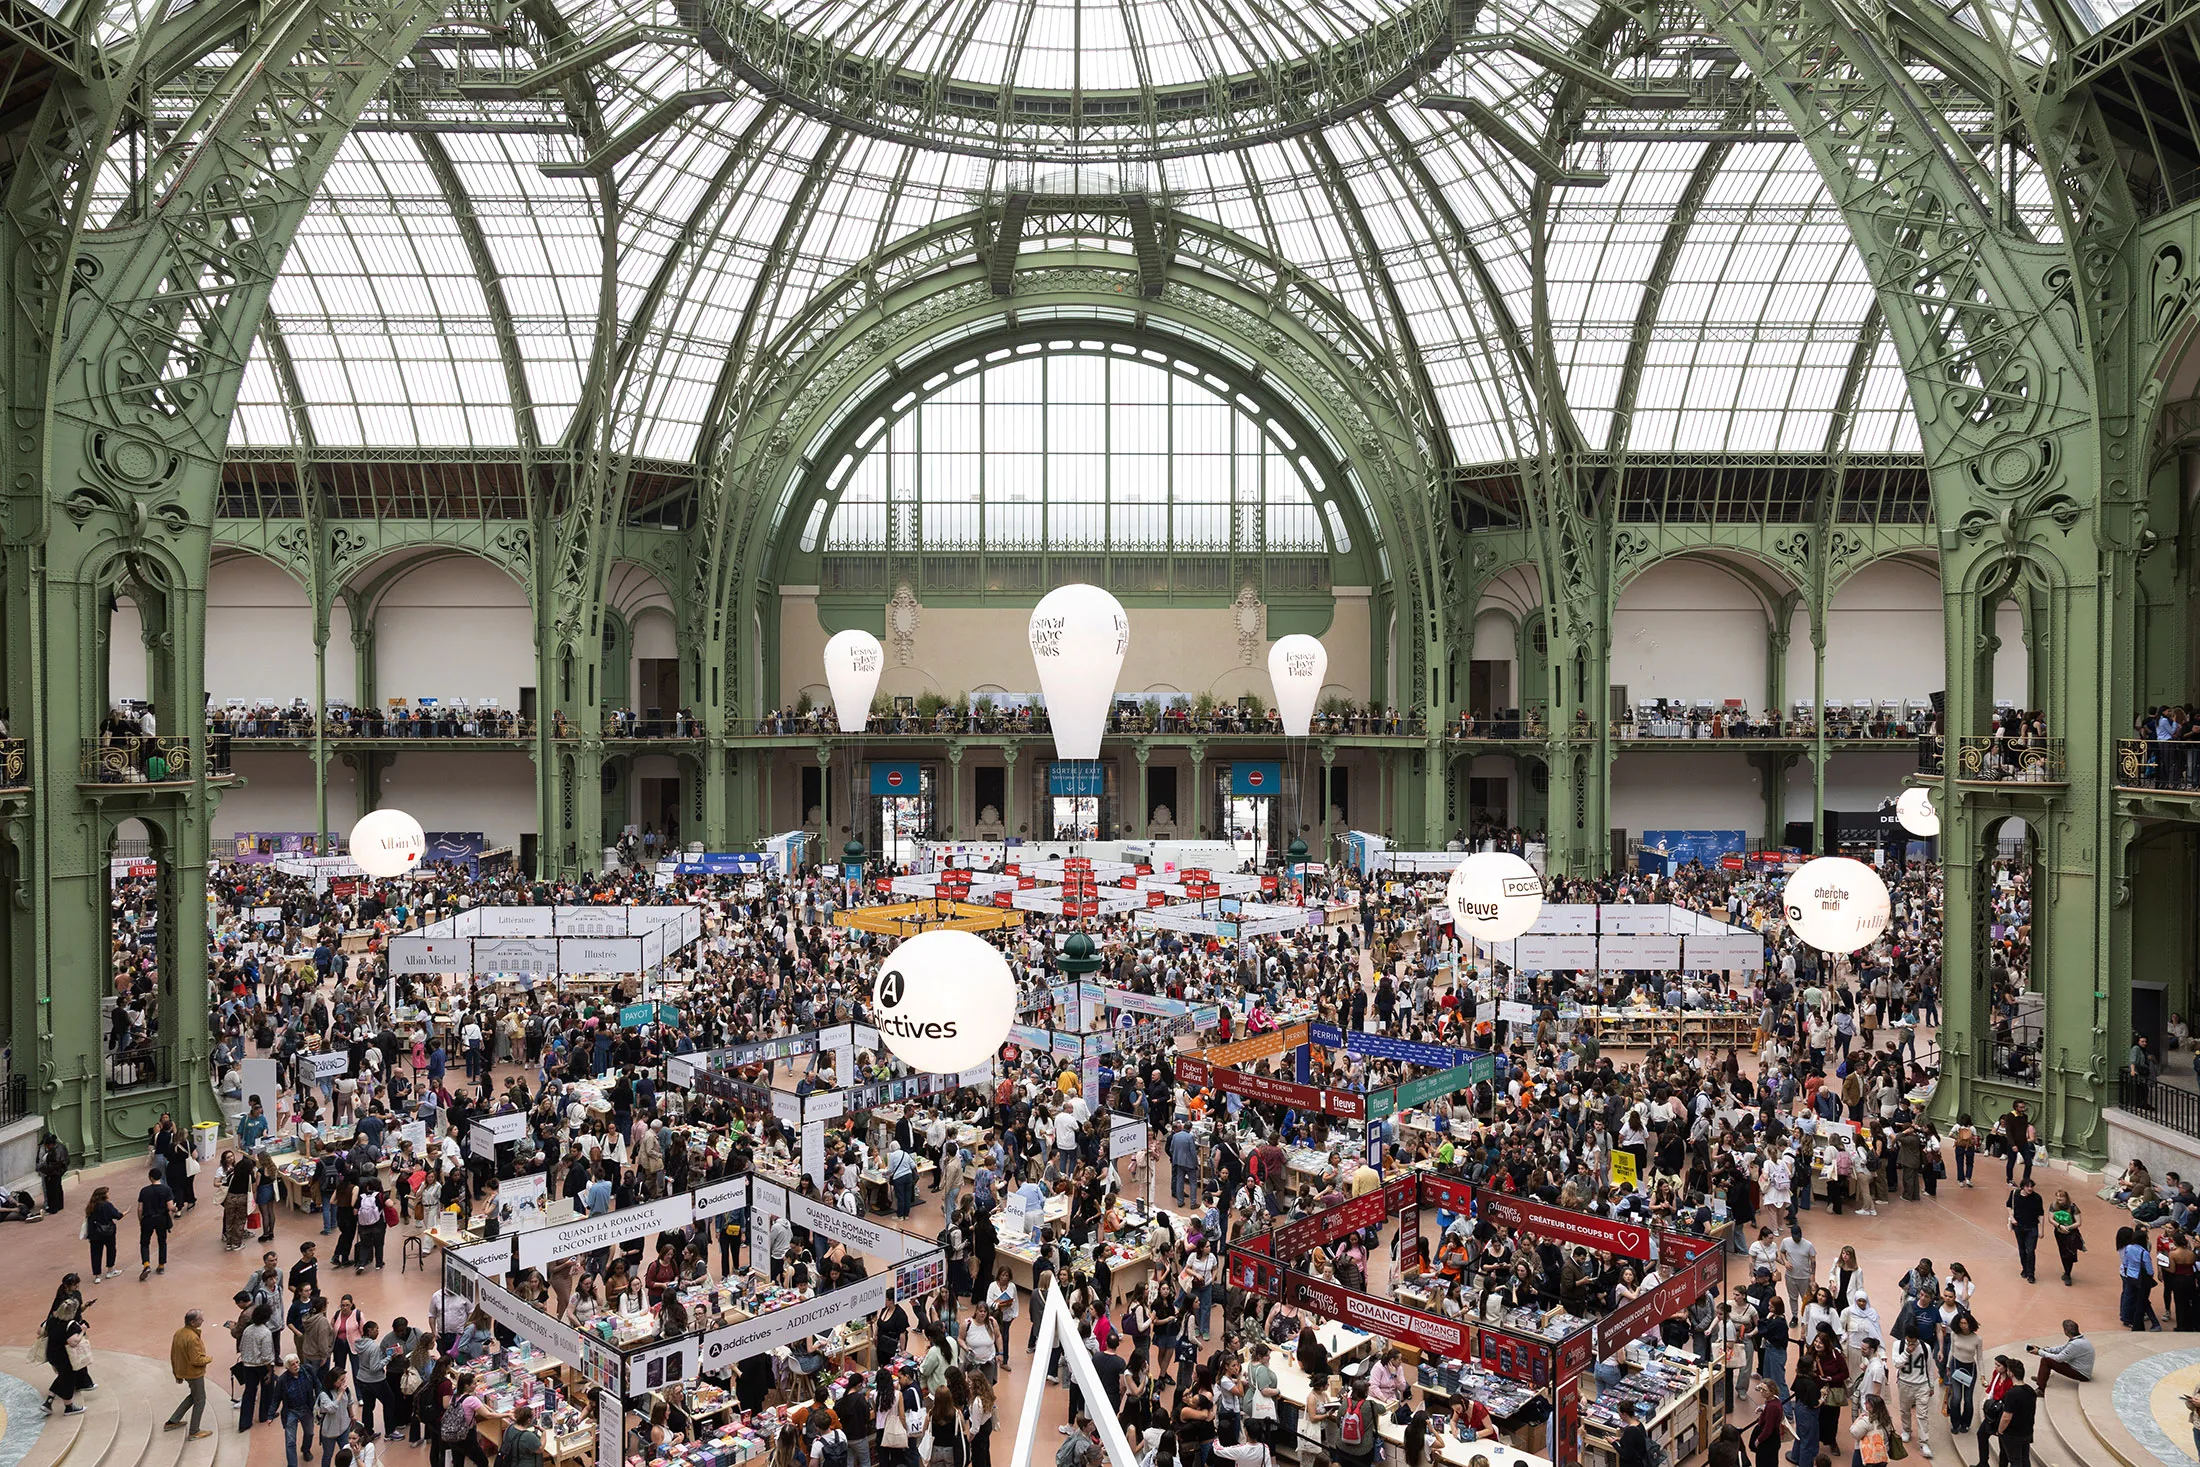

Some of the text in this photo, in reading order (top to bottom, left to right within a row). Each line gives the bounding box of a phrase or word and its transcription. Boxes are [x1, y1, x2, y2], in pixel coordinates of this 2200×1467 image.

[380, 835, 409, 850] Albin
[320, 868, 337, 877] folio
[1814, 886, 1849, 900] cherche
[1458, 896, 1499, 917] fleuve
[1822, 900, 1841, 911] midi
[498, 916, 536, 924] Littérature
[1856, 916, 1884, 932] julli
[404, 955, 456, 966] Albin Michel
[584, 950, 617, 958] Illustrés
[1083, 990, 1102, 999] POCKET
[1124, 998, 1142, 1006] POCKET
[625, 1010, 649, 1021] PAYOT
[1287, 1030, 1307, 1042] PERRIN
[1312, 1030, 1339, 1042] PERRIN
[1056, 1042, 1076, 1050] POCKET
[1183, 1062, 1203, 1074] Robert
[1182, 1070, 1203, 1082] Laffont
[1272, 1084, 1293, 1093] PERRIN
[810, 1104, 827, 1113] ACTES
[1285, 1098, 1306, 1107] REGARDE
[1333, 1096, 1356, 1111] fleuve
[1373, 1097, 1389, 1110] fleuve
[502, 1122, 518, 1130] MOTS
[1120, 1132, 1137, 1144] Grèce
[708, 1189, 744, 1204] addictives
[763, 1192, 782, 1208] ADONIA
[1008, 1205, 1024, 1218] Grèce
[1504, 1212, 1522, 1223] Web
[558, 1209, 655, 1242] QUAND LA ROMANCE
[806, 1208, 880, 1242] QUAND LA ROMANCE
[1529, 1214, 1615, 1241] CRÉATEUR DE COUPS DE
[552, 1218, 662, 1255] RENCONTRE LA FANTASY
[813, 1218, 874, 1248] SE FAIT SOMBRE
[471, 1252, 509, 1266] ddictives
[1318, 1299, 1339, 1316] Web
[1350, 1300, 1406, 1327] ROMANCE
[1635, 1308, 1646, 1319] COUP
[1646, 1303, 1652, 1312] DE
[723, 1329, 772, 1350] addictives
[786, 1305, 843, 1330] ADDICTASY
[859, 1286, 884, 1304] ADONIA
[516, 1312, 548, 1340] ADDICTASY
[1414, 1319, 1458, 1338] ROMANCE
